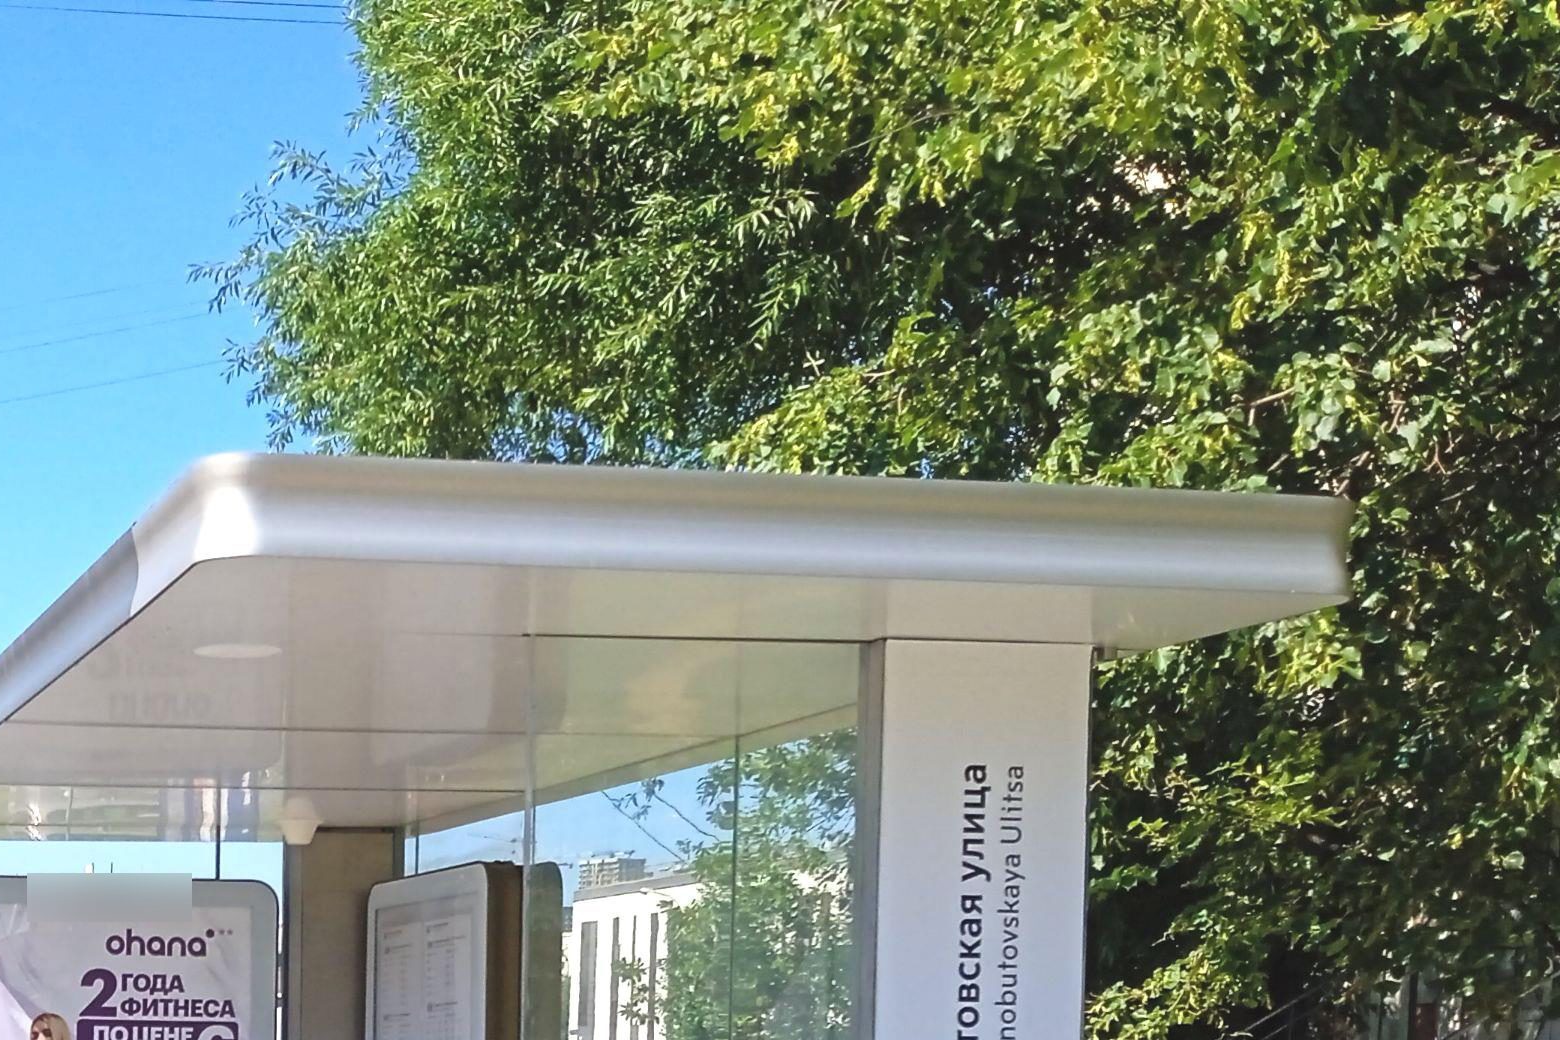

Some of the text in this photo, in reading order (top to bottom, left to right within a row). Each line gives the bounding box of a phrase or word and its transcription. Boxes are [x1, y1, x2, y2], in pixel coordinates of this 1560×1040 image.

[961, 762, 992, 883] улица
[1000, 765, 1025, 845] Ulitsa
[105, 928, 208, 957] ohana
[79, 968, 184, 1017] 2 ГОДА
[120, 997, 236, 1018] ФИТНЕСА
